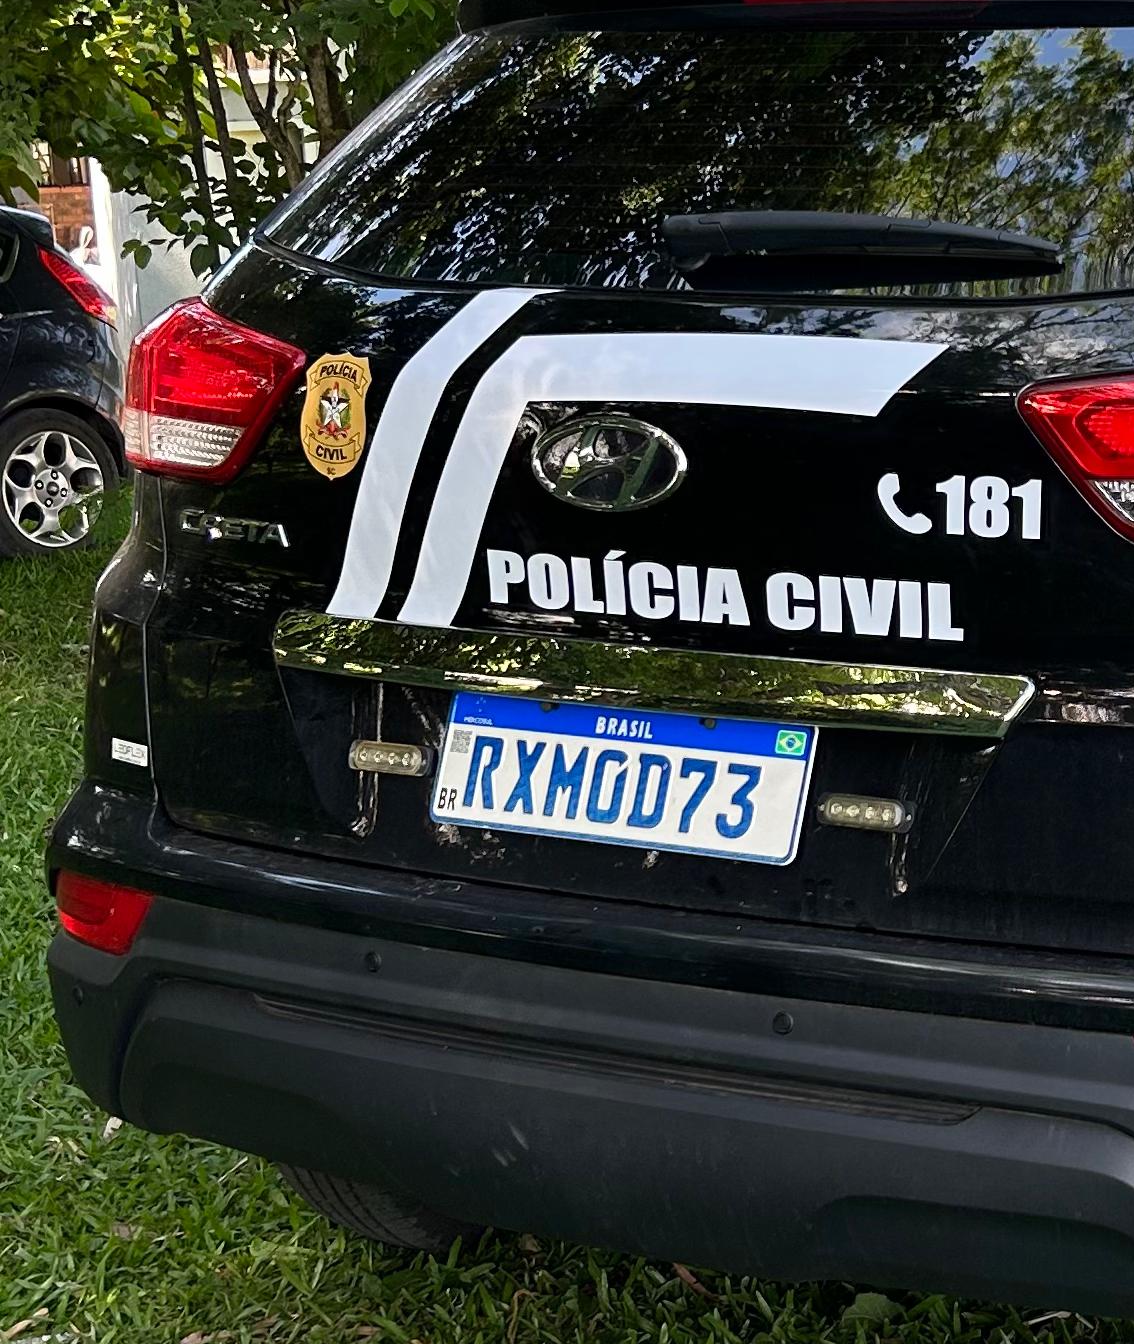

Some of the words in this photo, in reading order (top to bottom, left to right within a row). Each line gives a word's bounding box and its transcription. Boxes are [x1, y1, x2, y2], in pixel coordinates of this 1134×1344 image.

[320, 362, 358, 382] POLÍCIA
[315, 445, 348, 461] CIVIL
[936, 475, 1042, 540] 181
[487, 549, 750, 626] POLÍCIA
[765, 572, 965, 642] CIVIL
[595, 716, 653, 739] BRASIL
[437, 787, 458, 811] BR
